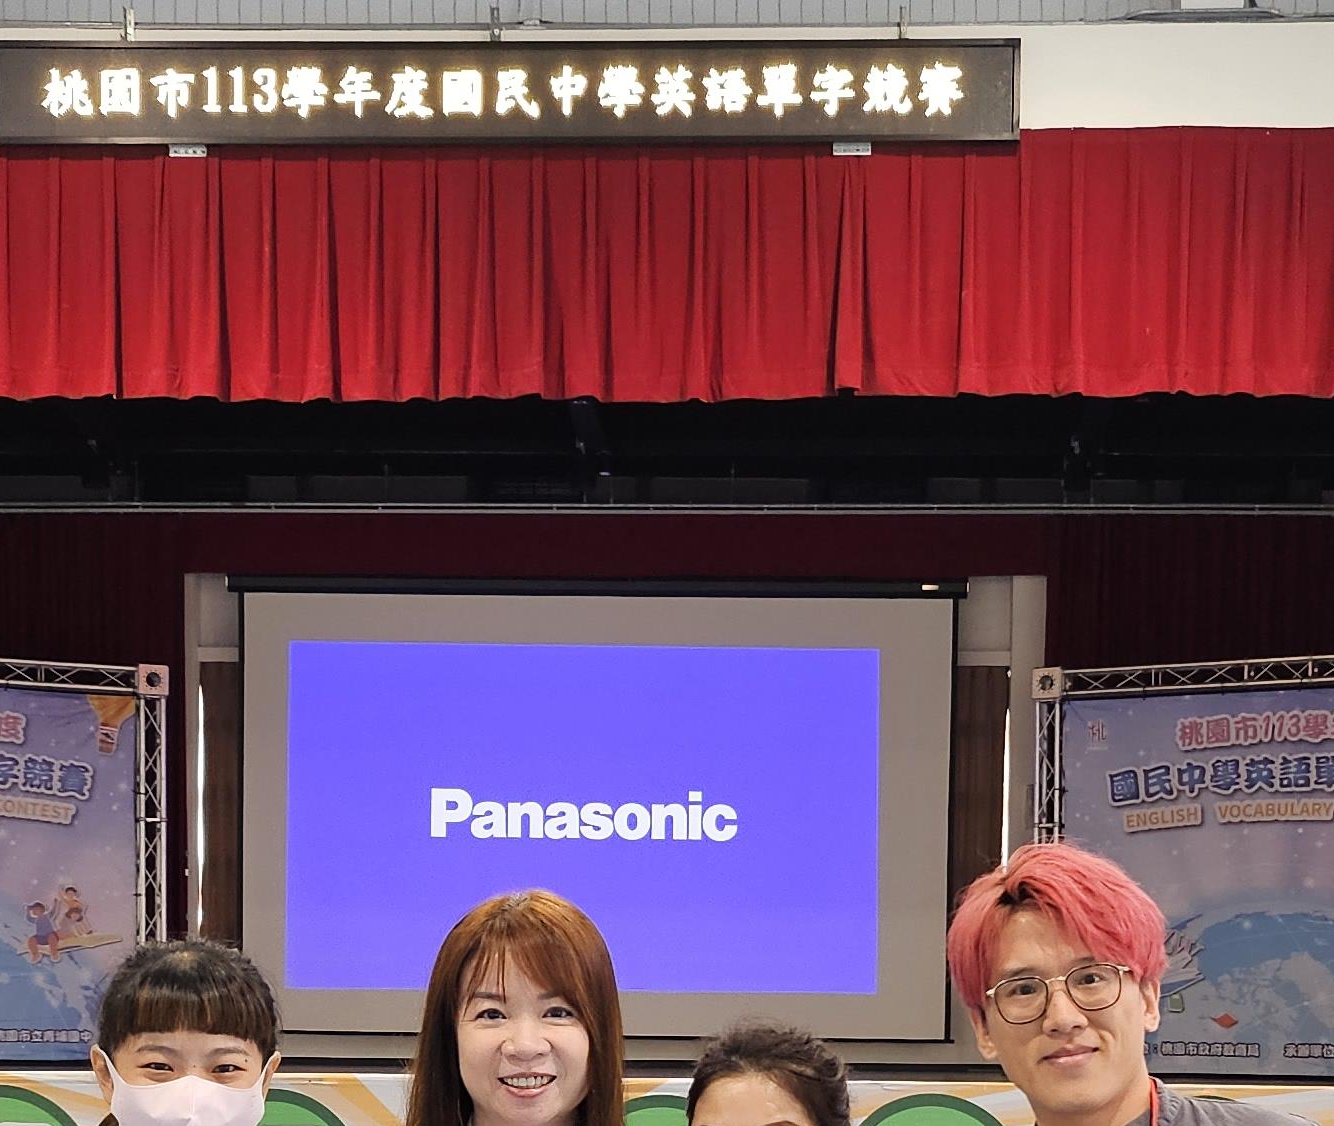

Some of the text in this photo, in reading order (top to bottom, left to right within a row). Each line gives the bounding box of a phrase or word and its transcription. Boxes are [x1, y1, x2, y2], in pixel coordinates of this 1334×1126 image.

[43, 64, 964, 119] 桃園市113學年度國民中學英語單字競賽
[430, 787, 738, 842] Panasonic
[1126, 807, 1199, 828] ENGLISH
[1217, 803, 1333, 820] VOCABULARY
